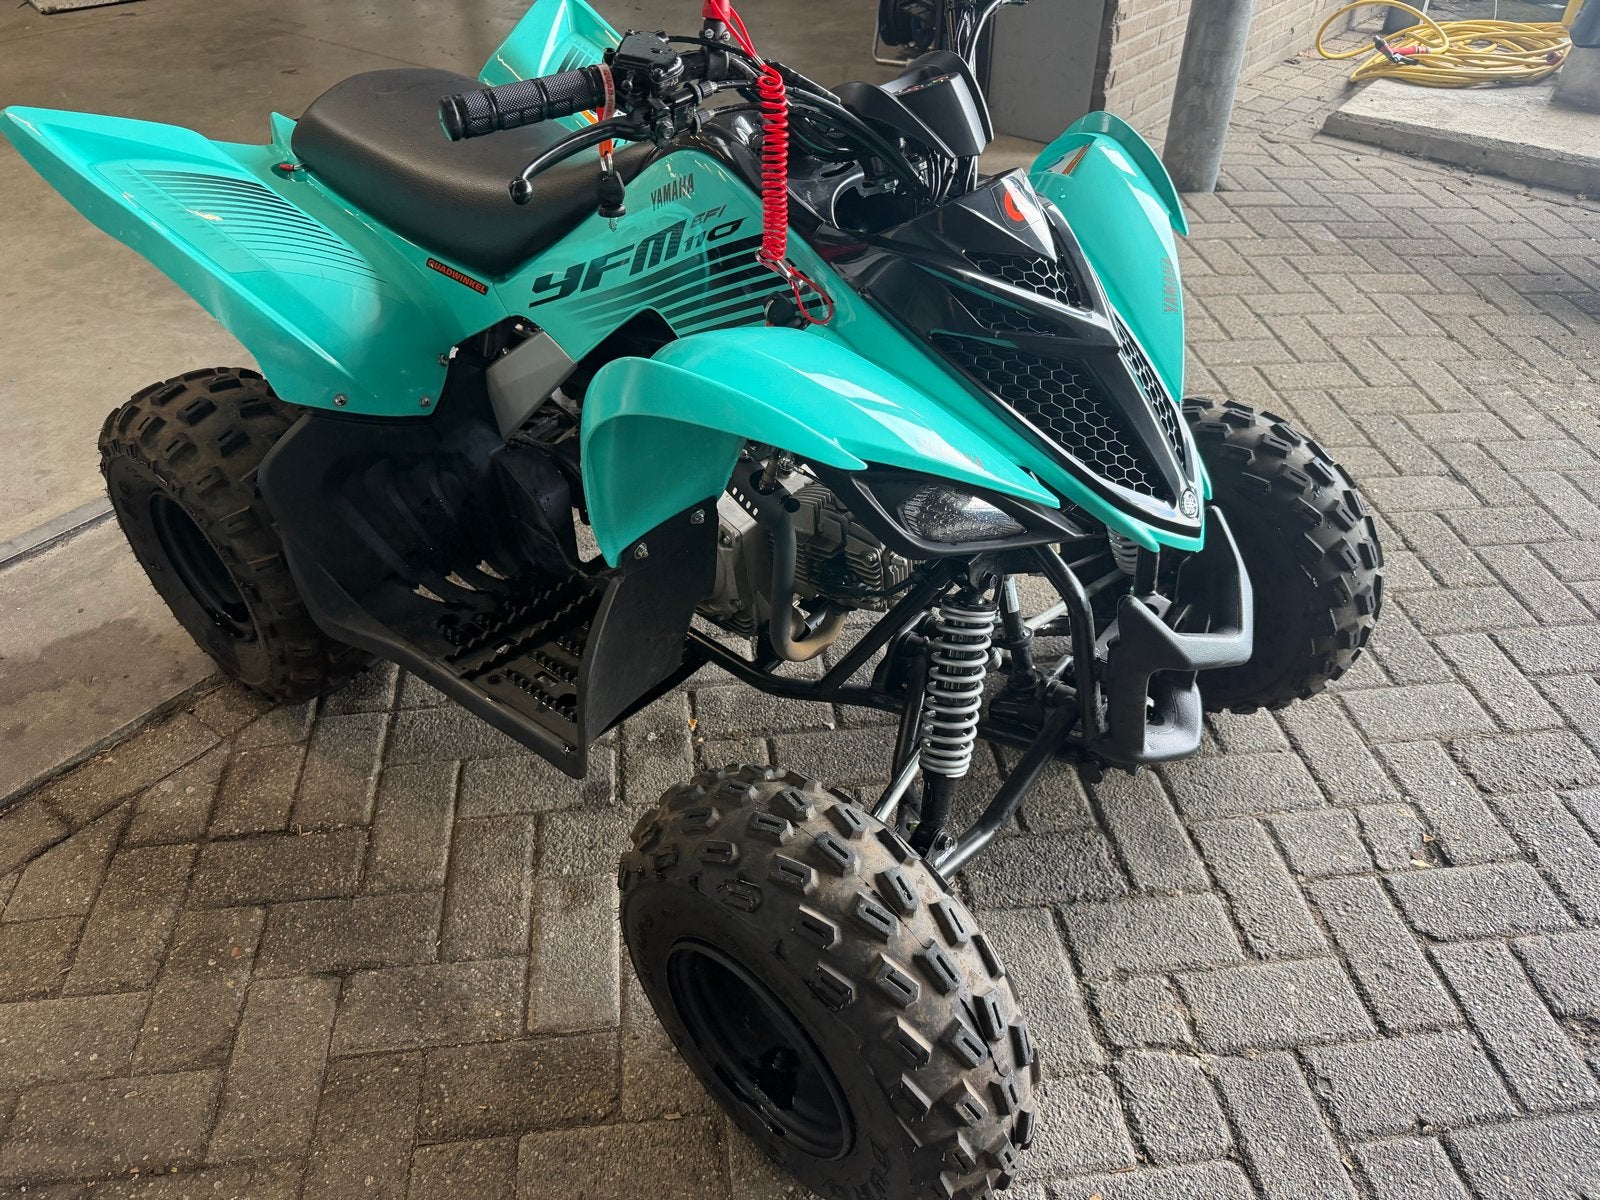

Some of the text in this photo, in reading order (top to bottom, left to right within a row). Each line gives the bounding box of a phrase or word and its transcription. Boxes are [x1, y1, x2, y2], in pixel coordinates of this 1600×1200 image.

[650, 172, 695, 212] YAMAHA
[689, 204, 728, 229] EFI
[427, 259, 486, 294] QUADWINKEL
